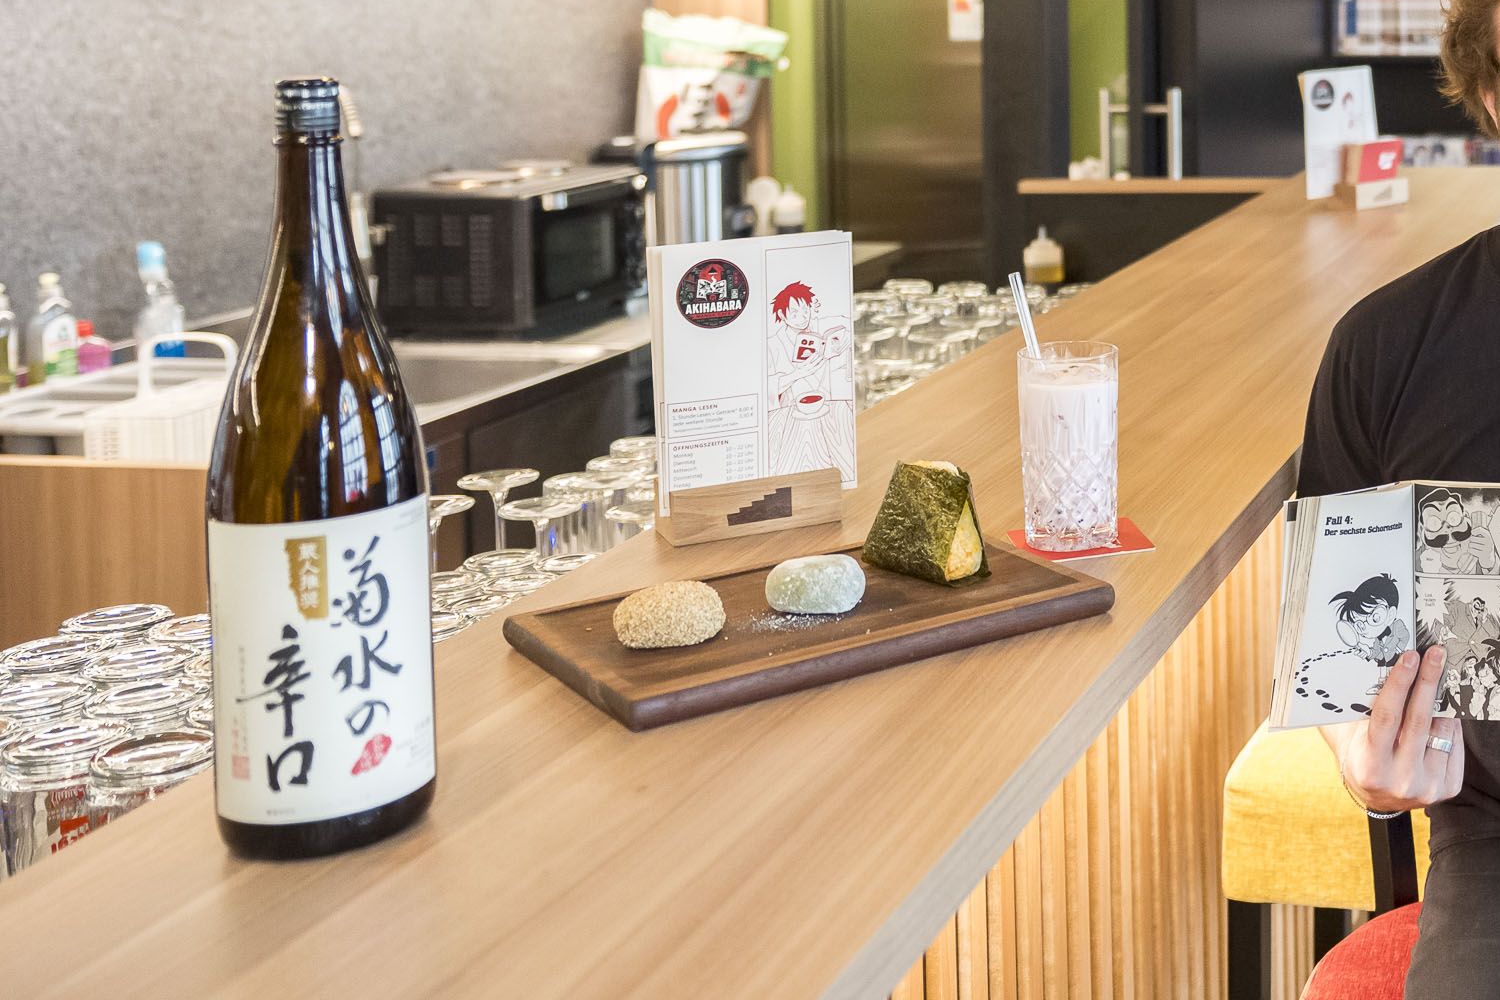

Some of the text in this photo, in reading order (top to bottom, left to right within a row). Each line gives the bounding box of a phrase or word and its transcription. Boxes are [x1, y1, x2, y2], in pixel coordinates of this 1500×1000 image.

[685, 299, 742, 315] AKIHABARA
[672, 440, 729, 452] ÖFFNUNGSZEITEN
[1325, 515, 1354, 526] Fall 4:
[1324, 521, 1403, 536] Der sechste Schornstein
[330, 535, 403, 736] 菊水の
[235, 624, 316, 792] 辛口
